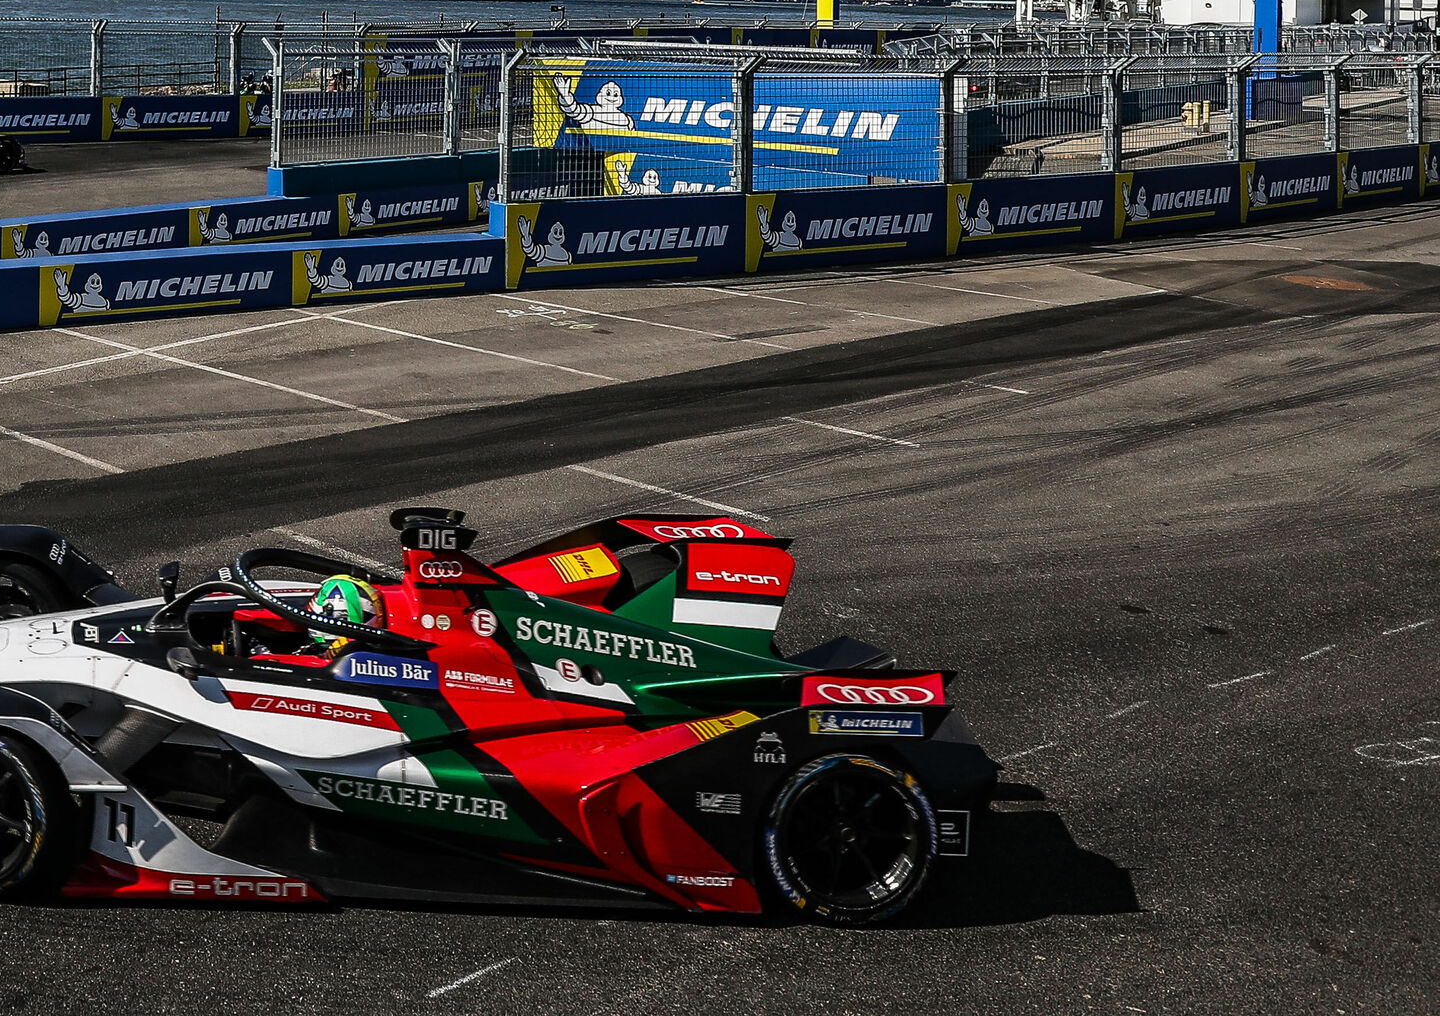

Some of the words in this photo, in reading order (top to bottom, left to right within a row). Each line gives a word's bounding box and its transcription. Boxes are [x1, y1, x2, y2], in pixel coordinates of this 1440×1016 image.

[143, 111, 230, 126] MICHELIN
[1269, 176, 1331, 198] MICHELIN
[1361, 166, 1414, 186] MICHELIN
[378, 197, 459, 219] MICHELIN
[1152, 187, 1232, 212] MICHELIN
[235, 210, 331, 234] MICHELIN
[997, 200, 1103, 227] MICHELIN
[806, 213, 933, 242] MICHELIN
[59, 226, 175, 254] MICHELIN
[577, 225, 729, 254] MICHELIN
[357, 256, 493, 283] MICHELIN
[115, 271, 273, 303] MICHELIN
[418, 529, 457, 550] DIG
[572, 553, 594, 576] DHL
[695, 570, 780, 586] e-tron
[516, 616, 696, 668] SCHAEFFLER
[350, 658, 398, 677] Julius
[401, 663, 433, 681] Bär
[445, 670, 463, 681] ABB
[275, 700, 317, 714] Audi
[321, 704, 373, 722] Sport
[842, 718, 913, 729] MICHELIN
[318, 776, 509, 821] SCHAEFFLER
[104, 798, 135, 847] 11
[169, 878, 309, 898] e-tron
[676, 875, 735, 886] FANBOOST
